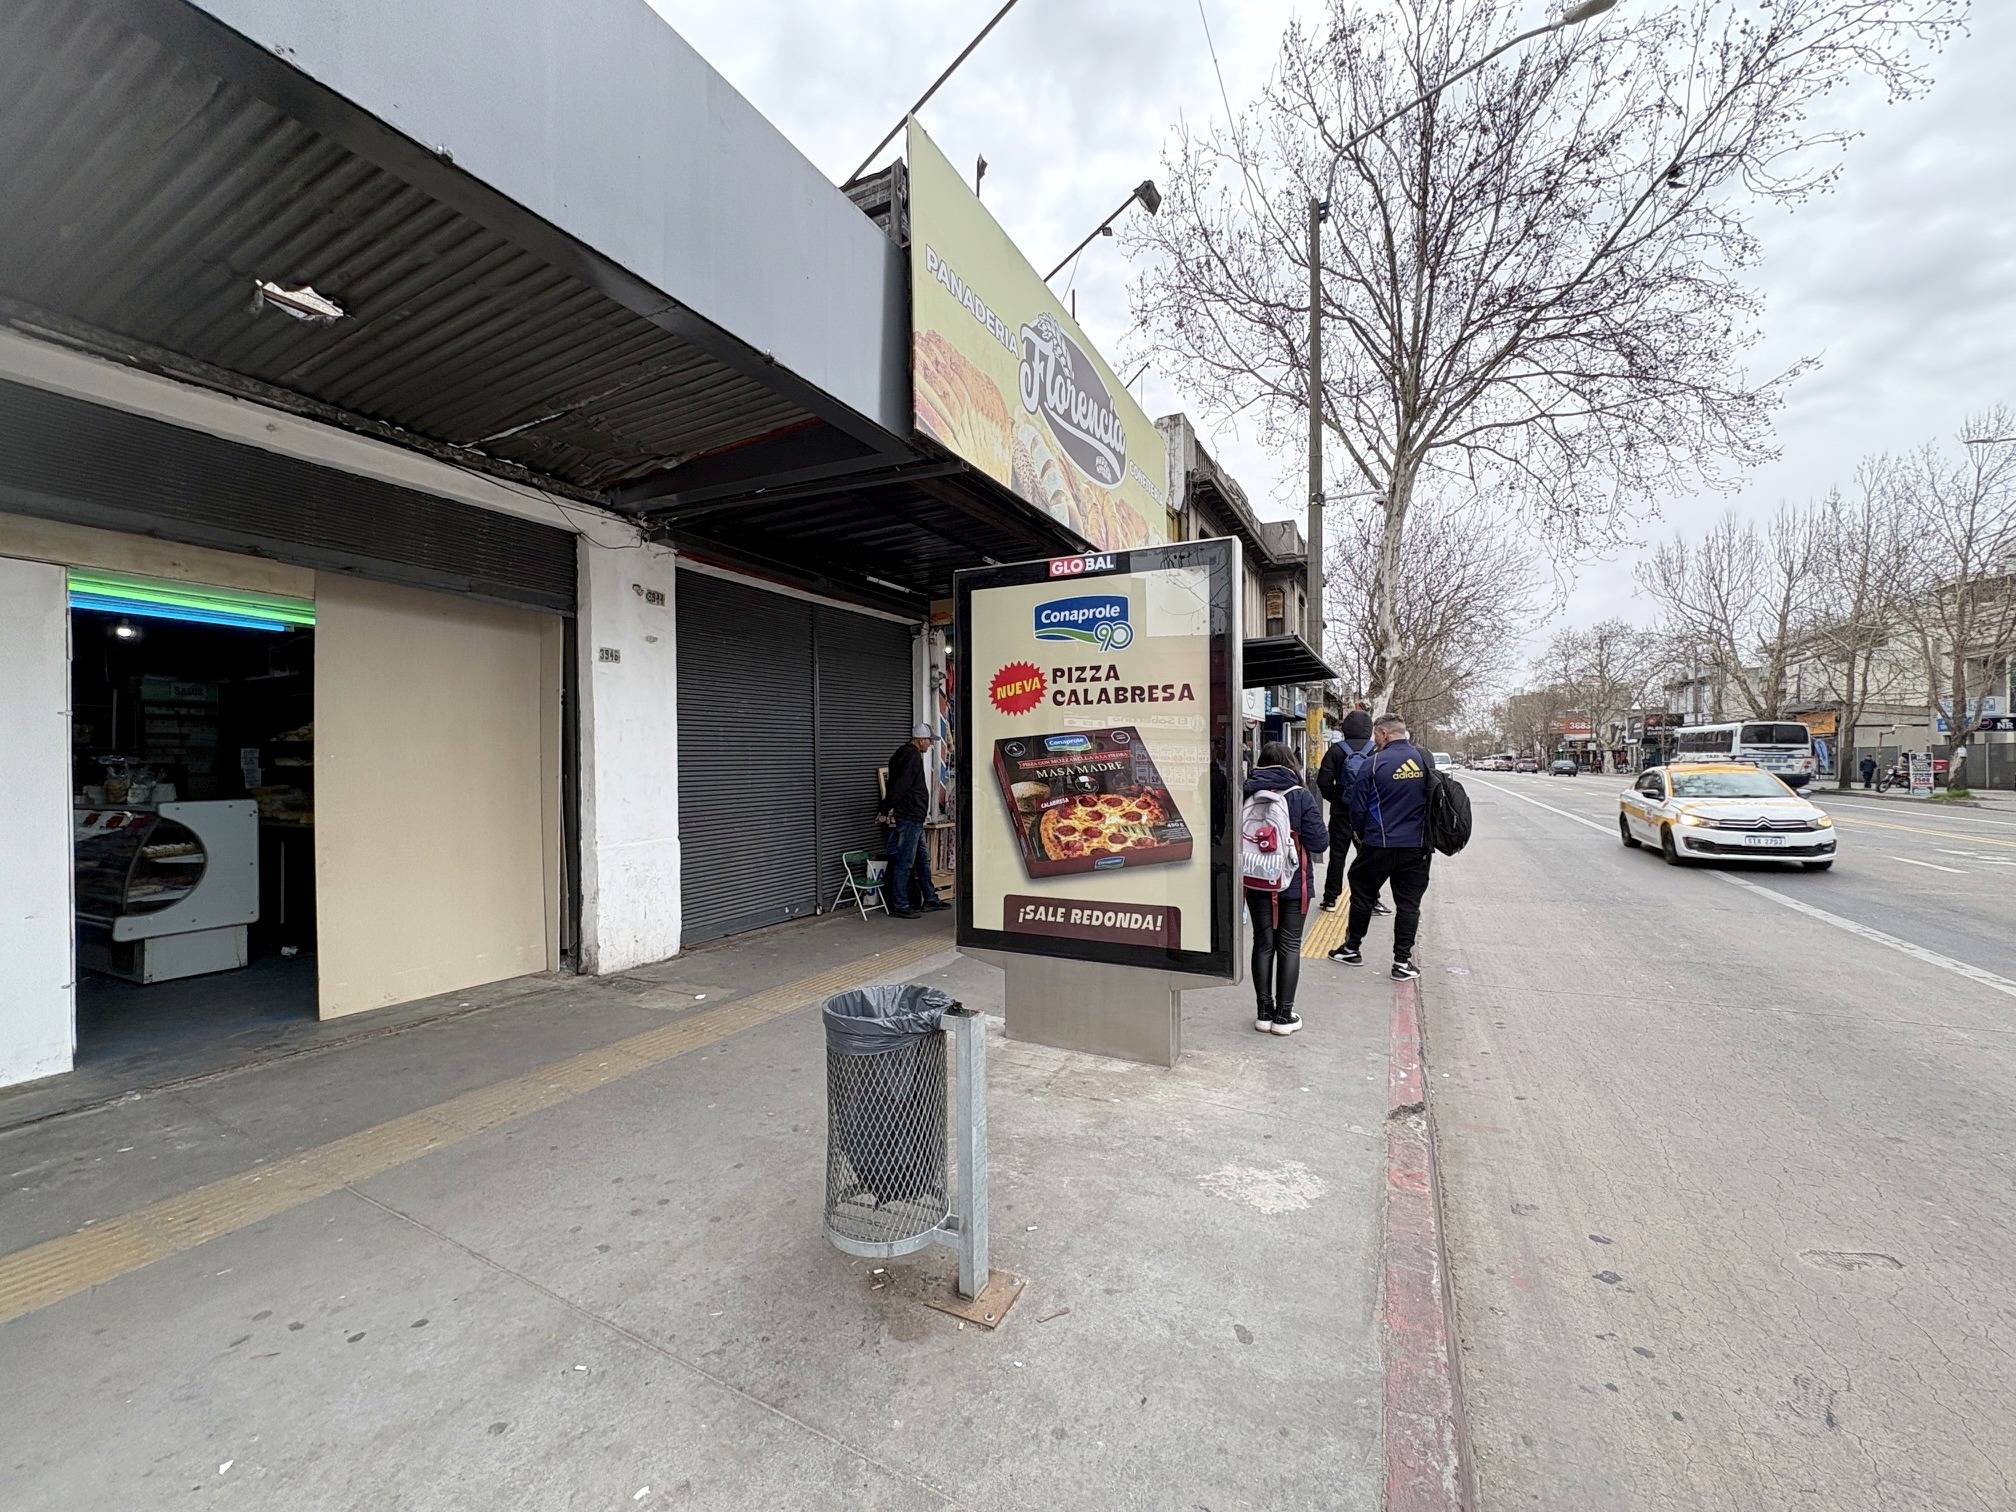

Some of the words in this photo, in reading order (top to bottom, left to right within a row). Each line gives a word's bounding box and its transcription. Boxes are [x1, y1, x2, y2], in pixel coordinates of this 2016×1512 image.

[925, 244, 1019, 360] PANADERIA
[1019, 322, 1126, 456] Florencia
[1051, 555, 1115, 577] GLOBAL
[1041, 604, 1121, 625] Conaprole
[1093, 620, 1134, 653] 90
[1051, 664, 1120, 684] PIZZA
[996, 676, 1041, 700] NUEVA
[1052, 683, 1196, 707] CALABRESA
[1049, 737, 1083, 747] Conaprole
[1036, 766, 1075, 779] MASA
[1076, 761, 1125, 775] MADRE
[1392, 770, 1424, 780] adidas
[1041, 797, 1070, 809] CALABRESA
[1018, 904, 1065, 924] ¡SALE
[1070, 908, 1164, 932] REDONDA!
